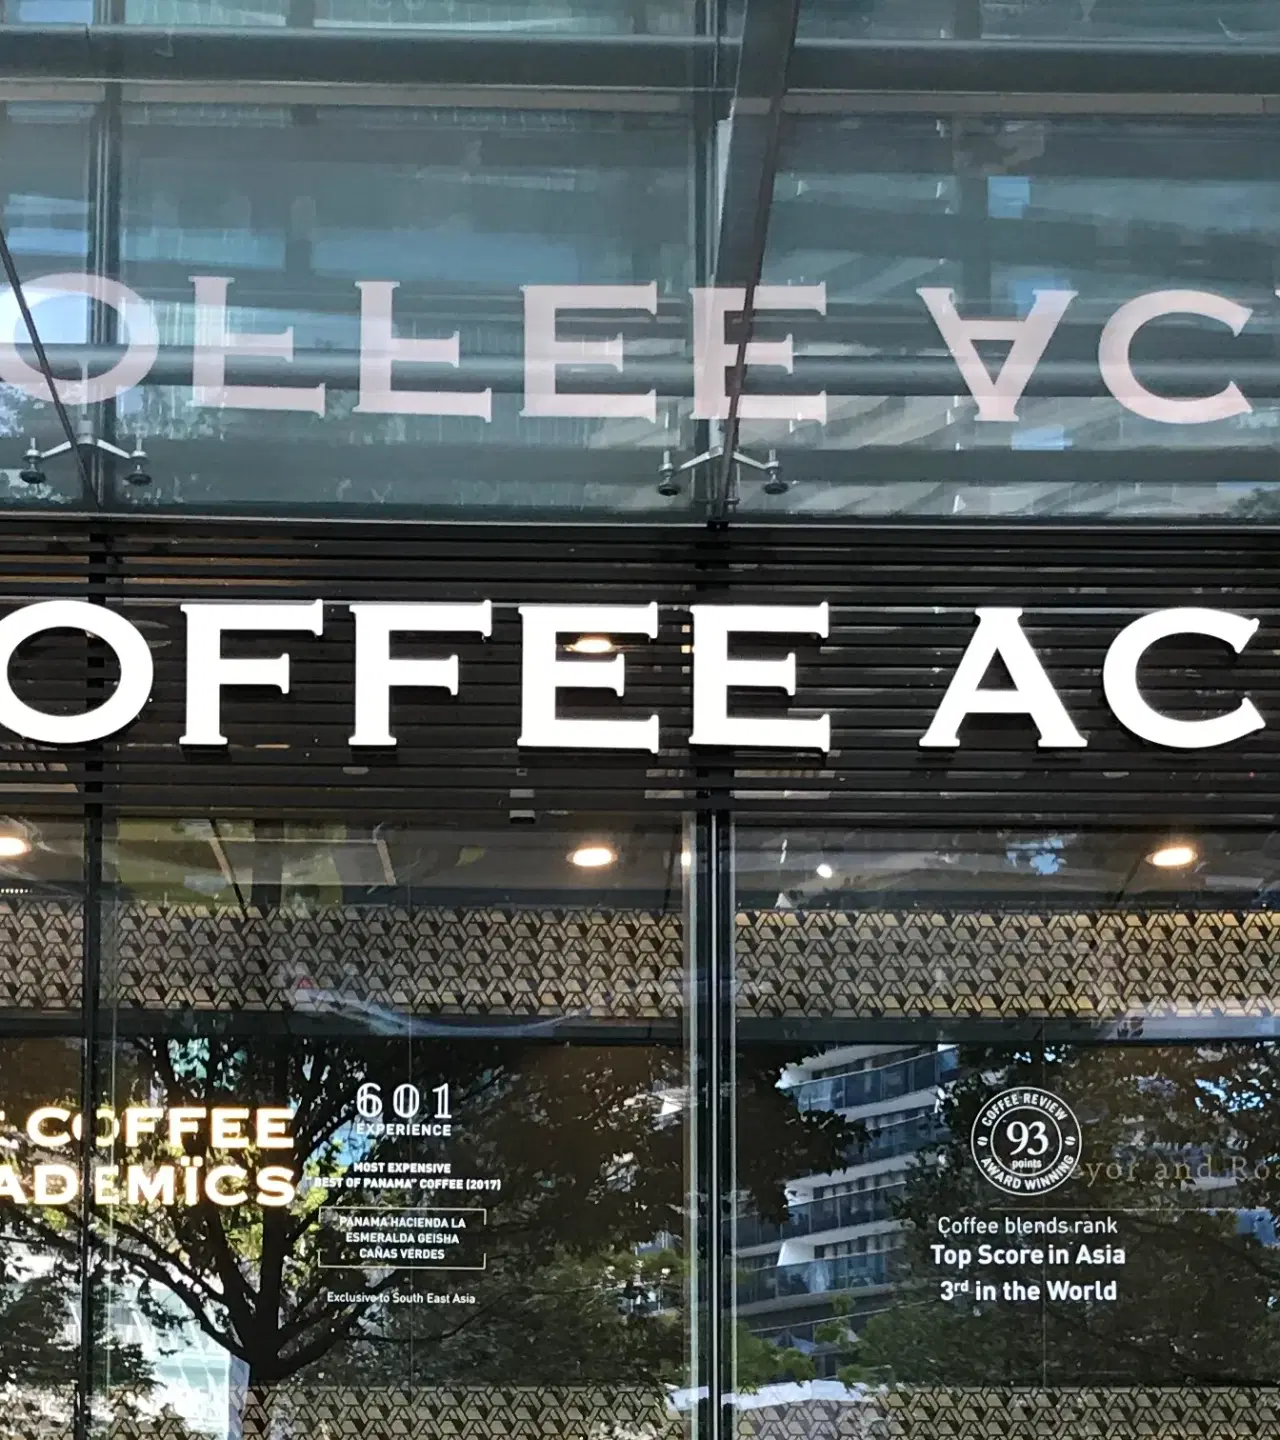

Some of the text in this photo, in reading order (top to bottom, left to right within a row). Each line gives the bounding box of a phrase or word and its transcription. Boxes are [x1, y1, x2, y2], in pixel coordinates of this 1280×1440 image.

[981, 1093, 1068, 1127] COFFEE REVIEW
[26, 1107, 296, 1149] COFFEE
[356, 1124, 452, 1136] EXPERIENCE
[1006, 1121, 1049, 1156] 93
[354, 1163, 451, 1173] MOST EXPENSIVE
[1012, 1159, 1042, 1170] points
[981, 1157, 1021, 1190] AWARD
[1024, 1154, 1075, 1191] WINNING
[347, 1178, 361, 1188] OF
[420, 1179, 463, 1189] COFFEE
[466, 1179, 501, 1190] (2017)
[339, 1217, 466, 1228] PANAMA HACIENDA LA
[938, 1217, 1118, 1234] Coffee blends rank
[346, 1233, 460, 1244] ESMERALDA GEISHA
[359, 1246, 445, 1259] CAÑAS VERDES
[930, 1244, 1126, 1269] Top Score in Asia
[975, 1281, 996, 1301] in
[1003, 1281, 1040, 1301] the
[1046, 1281, 1117, 1301] World
[327, 1292, 475, 1304] Exclusive to South East Asia
